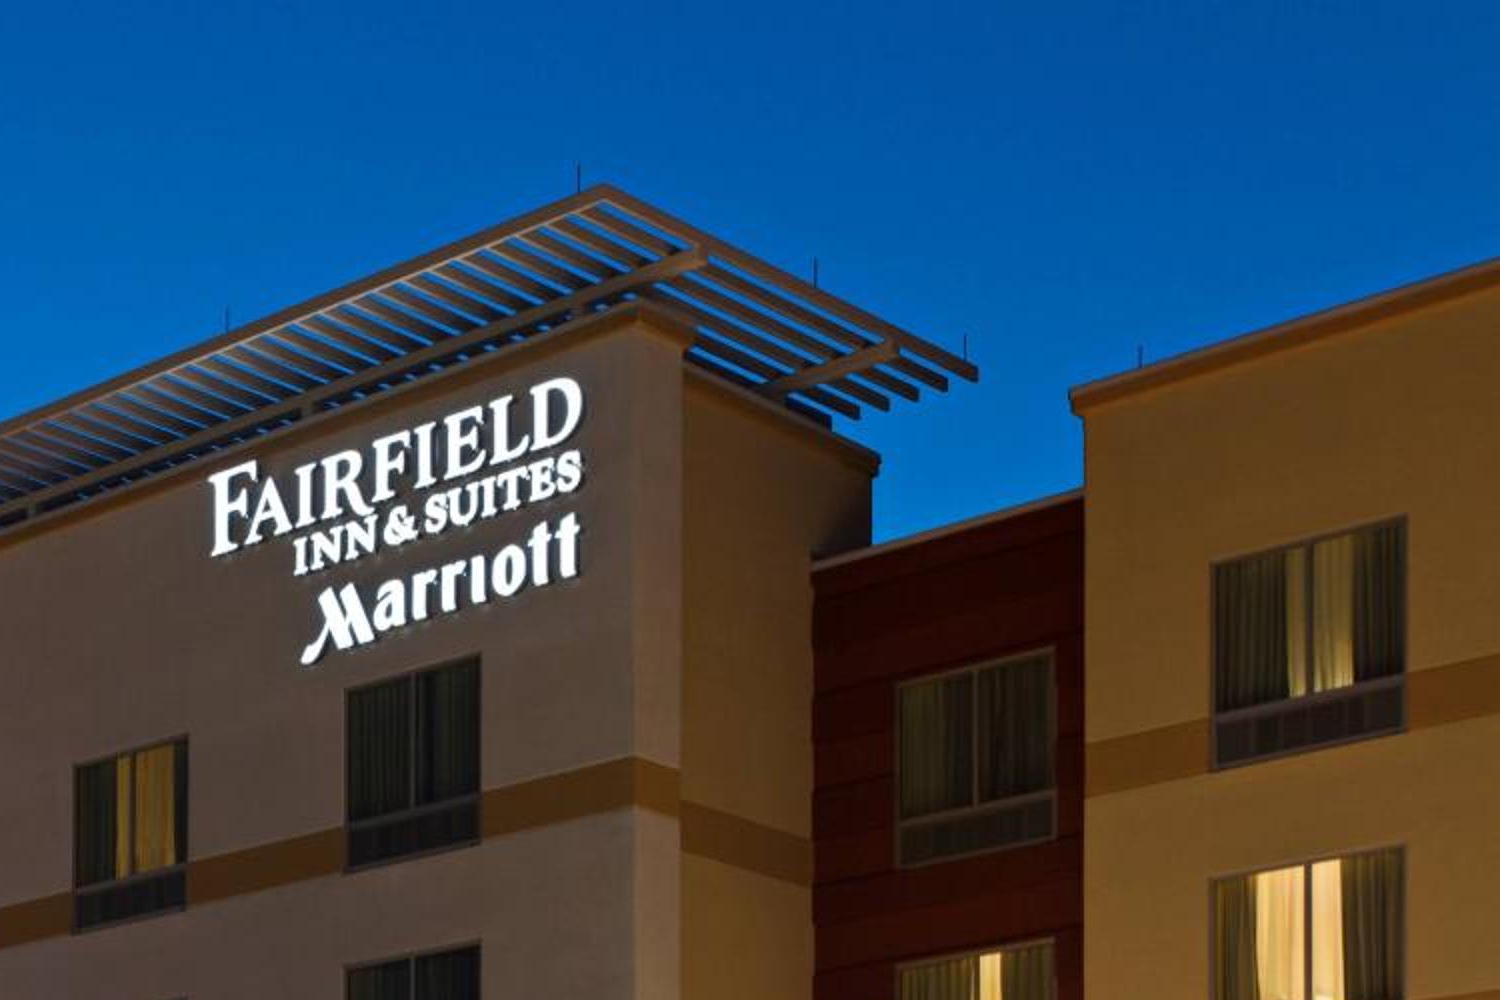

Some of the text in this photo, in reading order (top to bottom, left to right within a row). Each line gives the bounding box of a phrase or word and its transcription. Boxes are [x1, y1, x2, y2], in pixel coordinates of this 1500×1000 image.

[208, 377, 583, 556] FAIRFIELD
[424, 450, 582, 533] SUITES
[300, 512, 581, 665] Marriott
